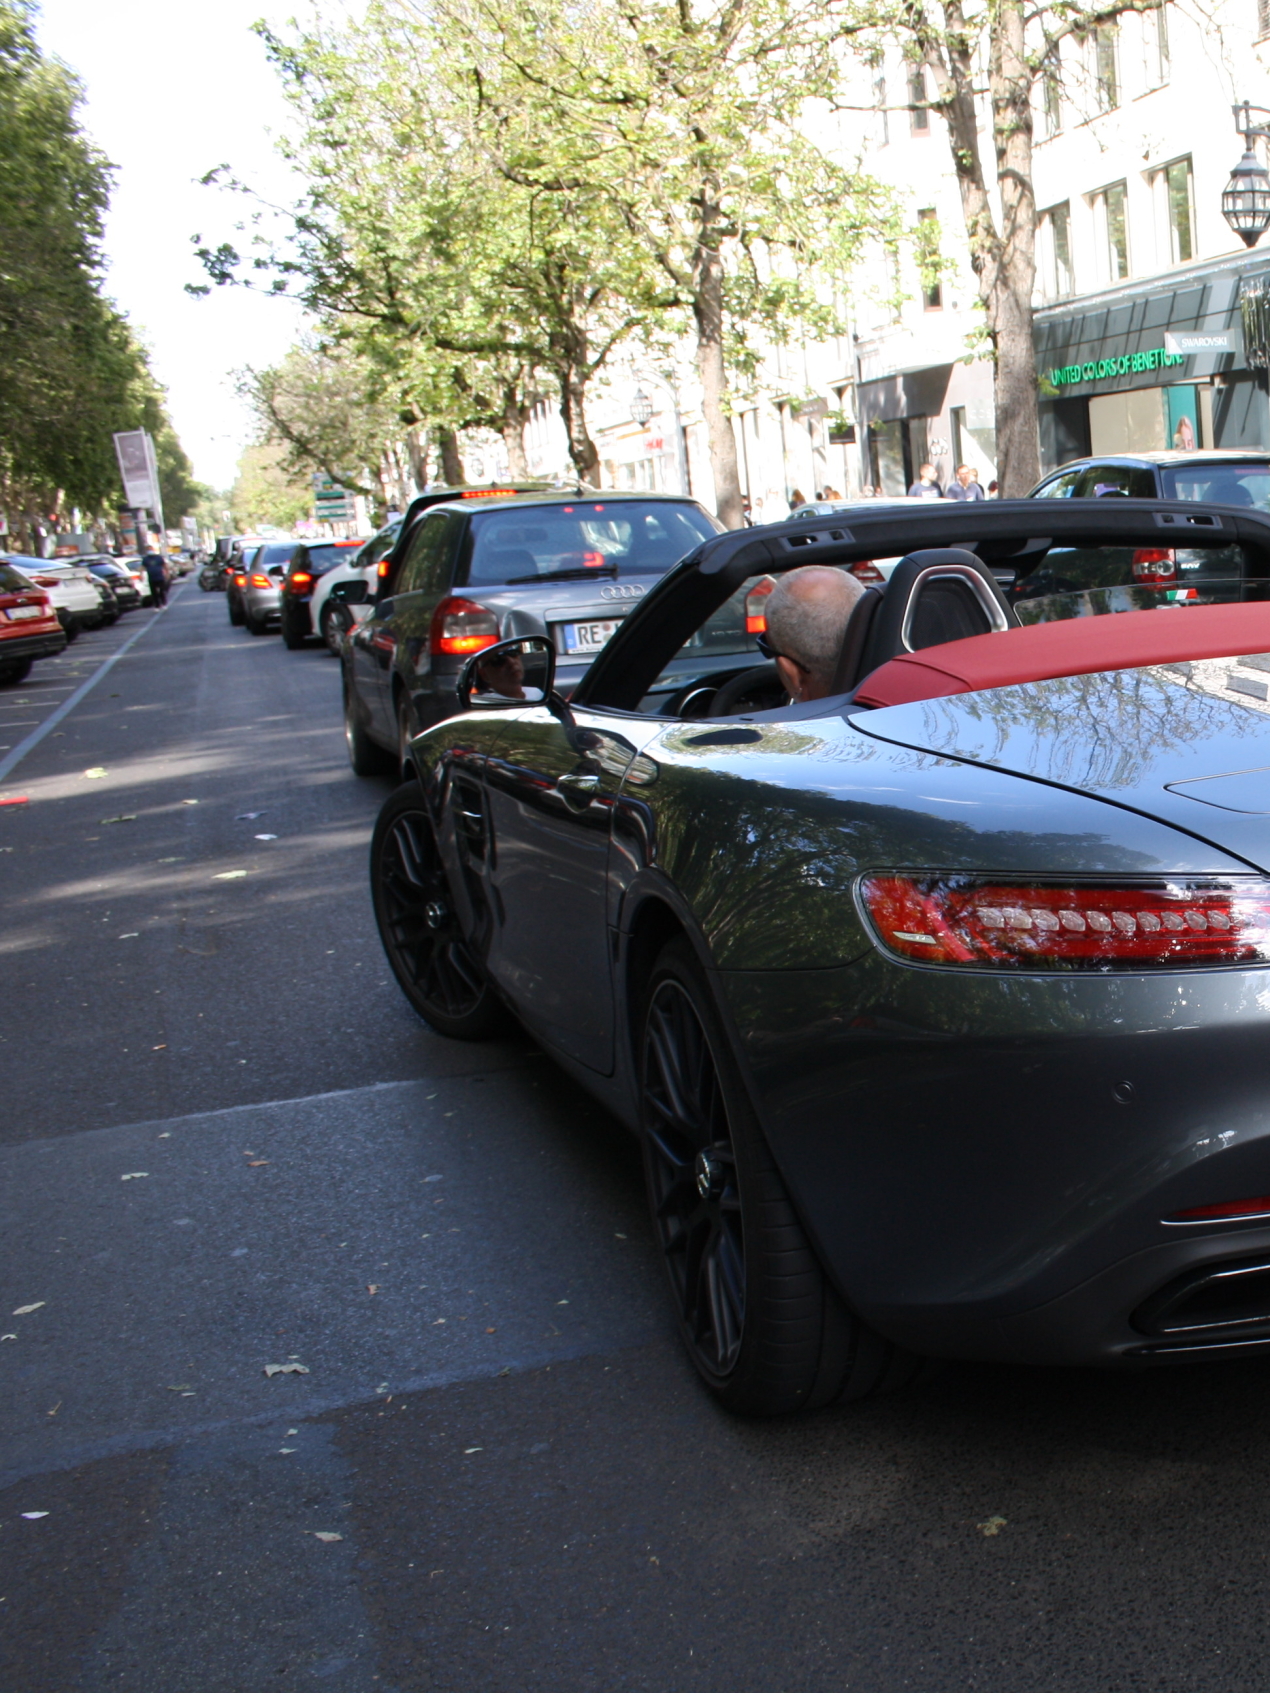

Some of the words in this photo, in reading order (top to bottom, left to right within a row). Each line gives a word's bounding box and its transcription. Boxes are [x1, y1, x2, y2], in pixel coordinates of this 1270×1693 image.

[1181, 336, 1228, 348] SWAROVSKI
[1050, 364, 1082, 386] UNITED
[1082, 358, 1118, 381] COLORS
[1117, 355, 1131, 376] OF
[577, 624, 601, 646] RE
